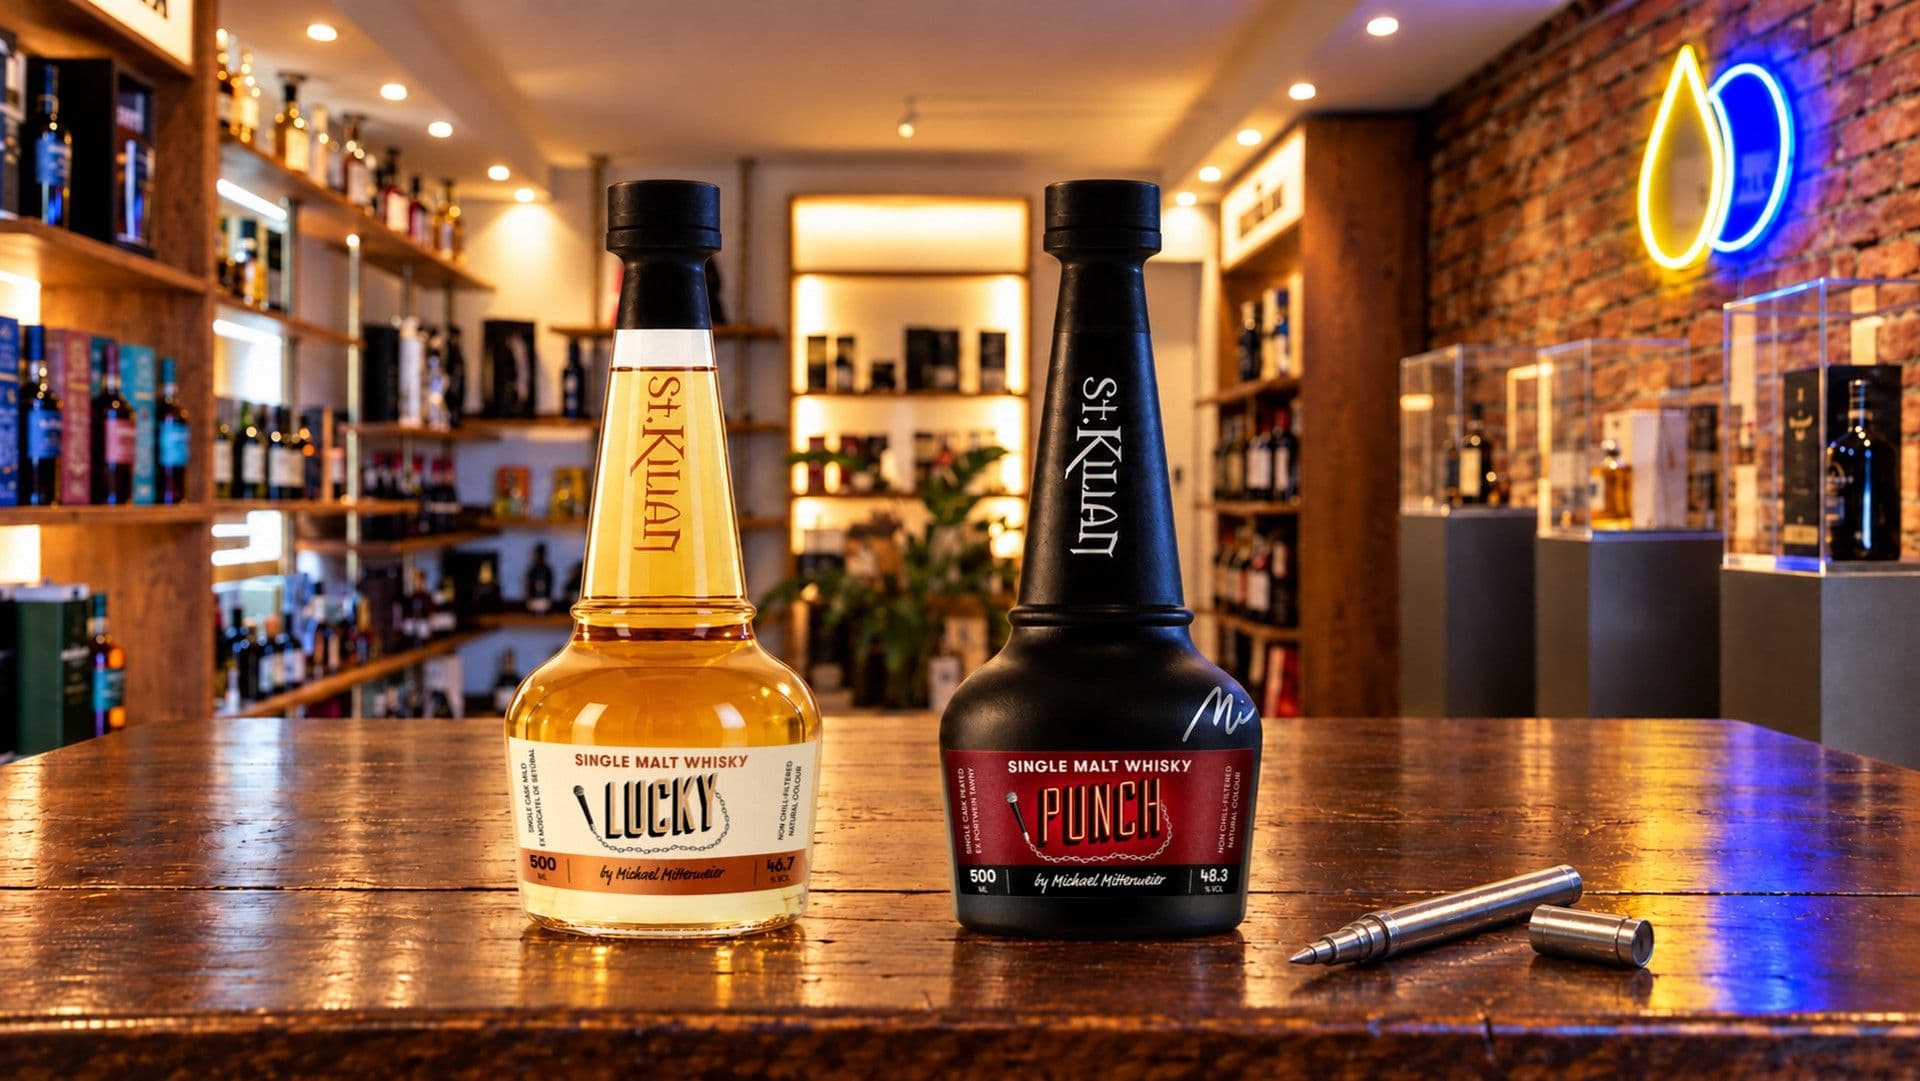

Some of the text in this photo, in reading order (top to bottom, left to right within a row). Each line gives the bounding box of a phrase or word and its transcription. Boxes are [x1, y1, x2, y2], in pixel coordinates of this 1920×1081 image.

[520, 762, 528, 783] MILD
[574, 753, 748, 770] SINGLE MALT WHISKY
[1007, 760, 1192, 774] SINGLE MALT WHISKY
[532, 784, 540, 796] DE
[958, 768, 966, 798] PEATED
[605, 773, 719, 840] LUCKY
[777, 760, 794, 840] NON CHILL-FILTERED
[788, 766, 802, 837] NATURAL COLOUR
[967, 768, 982, 854] EX PORTWEIN TAWNY
[1220, 766, 1232, 832] CHILL-FILTERED
[1228, 772, 1241, 848] NATURAL COLOUR
[526, 807, 534, 833] SINGLE
[534, 797, 545, 837] MOSCATEL
[1038, 778, 1161, 847] PUNCH
[539, 838, 546, 848] EX
[963, 824, 972, 854] SINGLE
[530, 854, 557, 871] 500
[766, 856, 795, 872] 46.7
[600, 865, 726, 886] by Michael Mittermeier
[970, 868, 996, 883] 500
[1034, 872, 1166, 894] by Michael Mittermeier
[1200, 868, 1228, 882] 48.3
